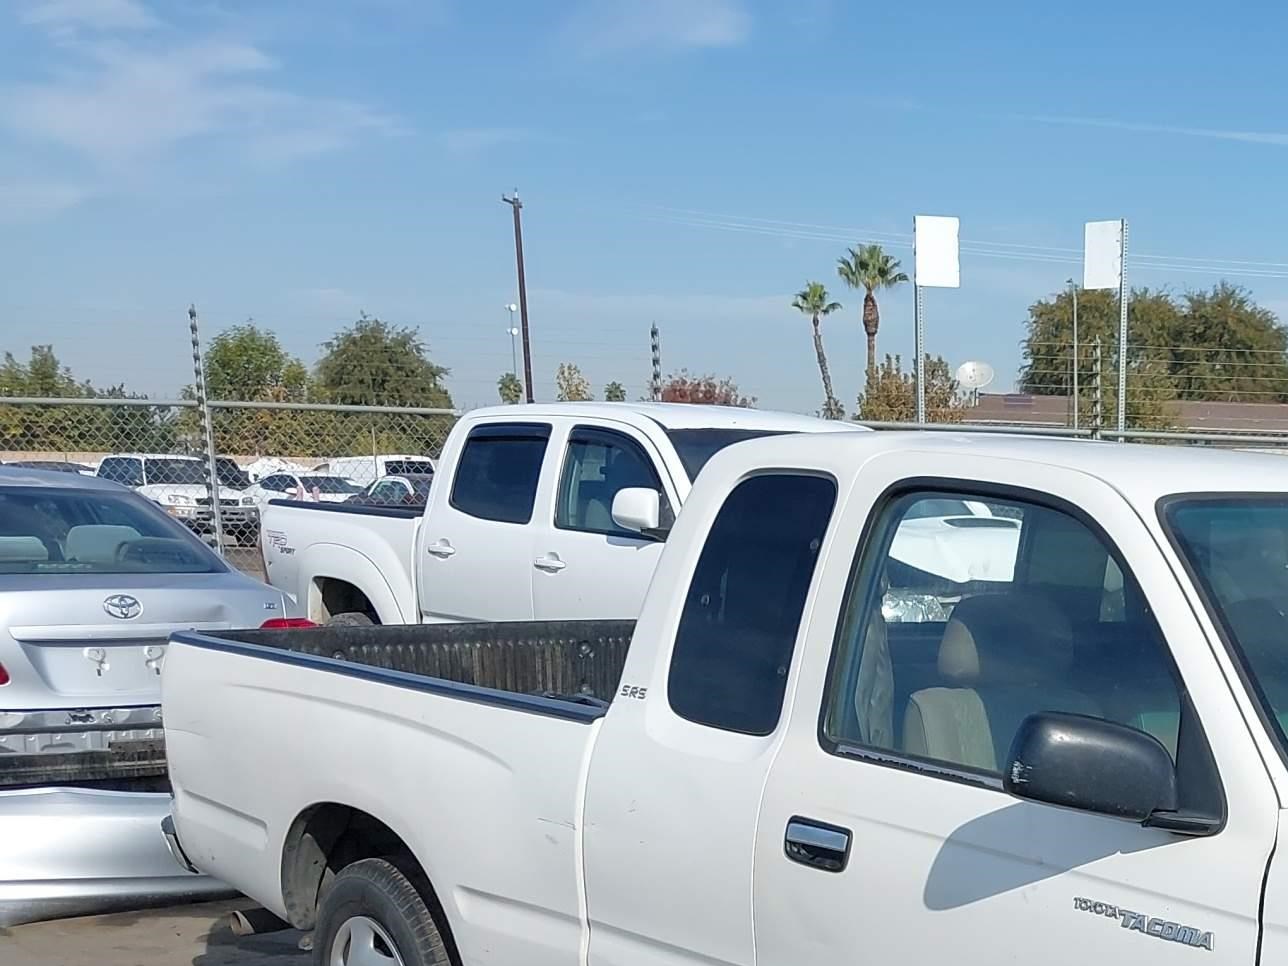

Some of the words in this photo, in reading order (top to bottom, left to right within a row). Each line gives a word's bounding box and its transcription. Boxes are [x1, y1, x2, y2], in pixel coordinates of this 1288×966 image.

[280, 547, 297, 555] SPORT
[620, 684, 648, 700] SRS
[1073, 896, 1120, 919] TOYOTA
[1119, 909, 1215, 951] TACOMA
